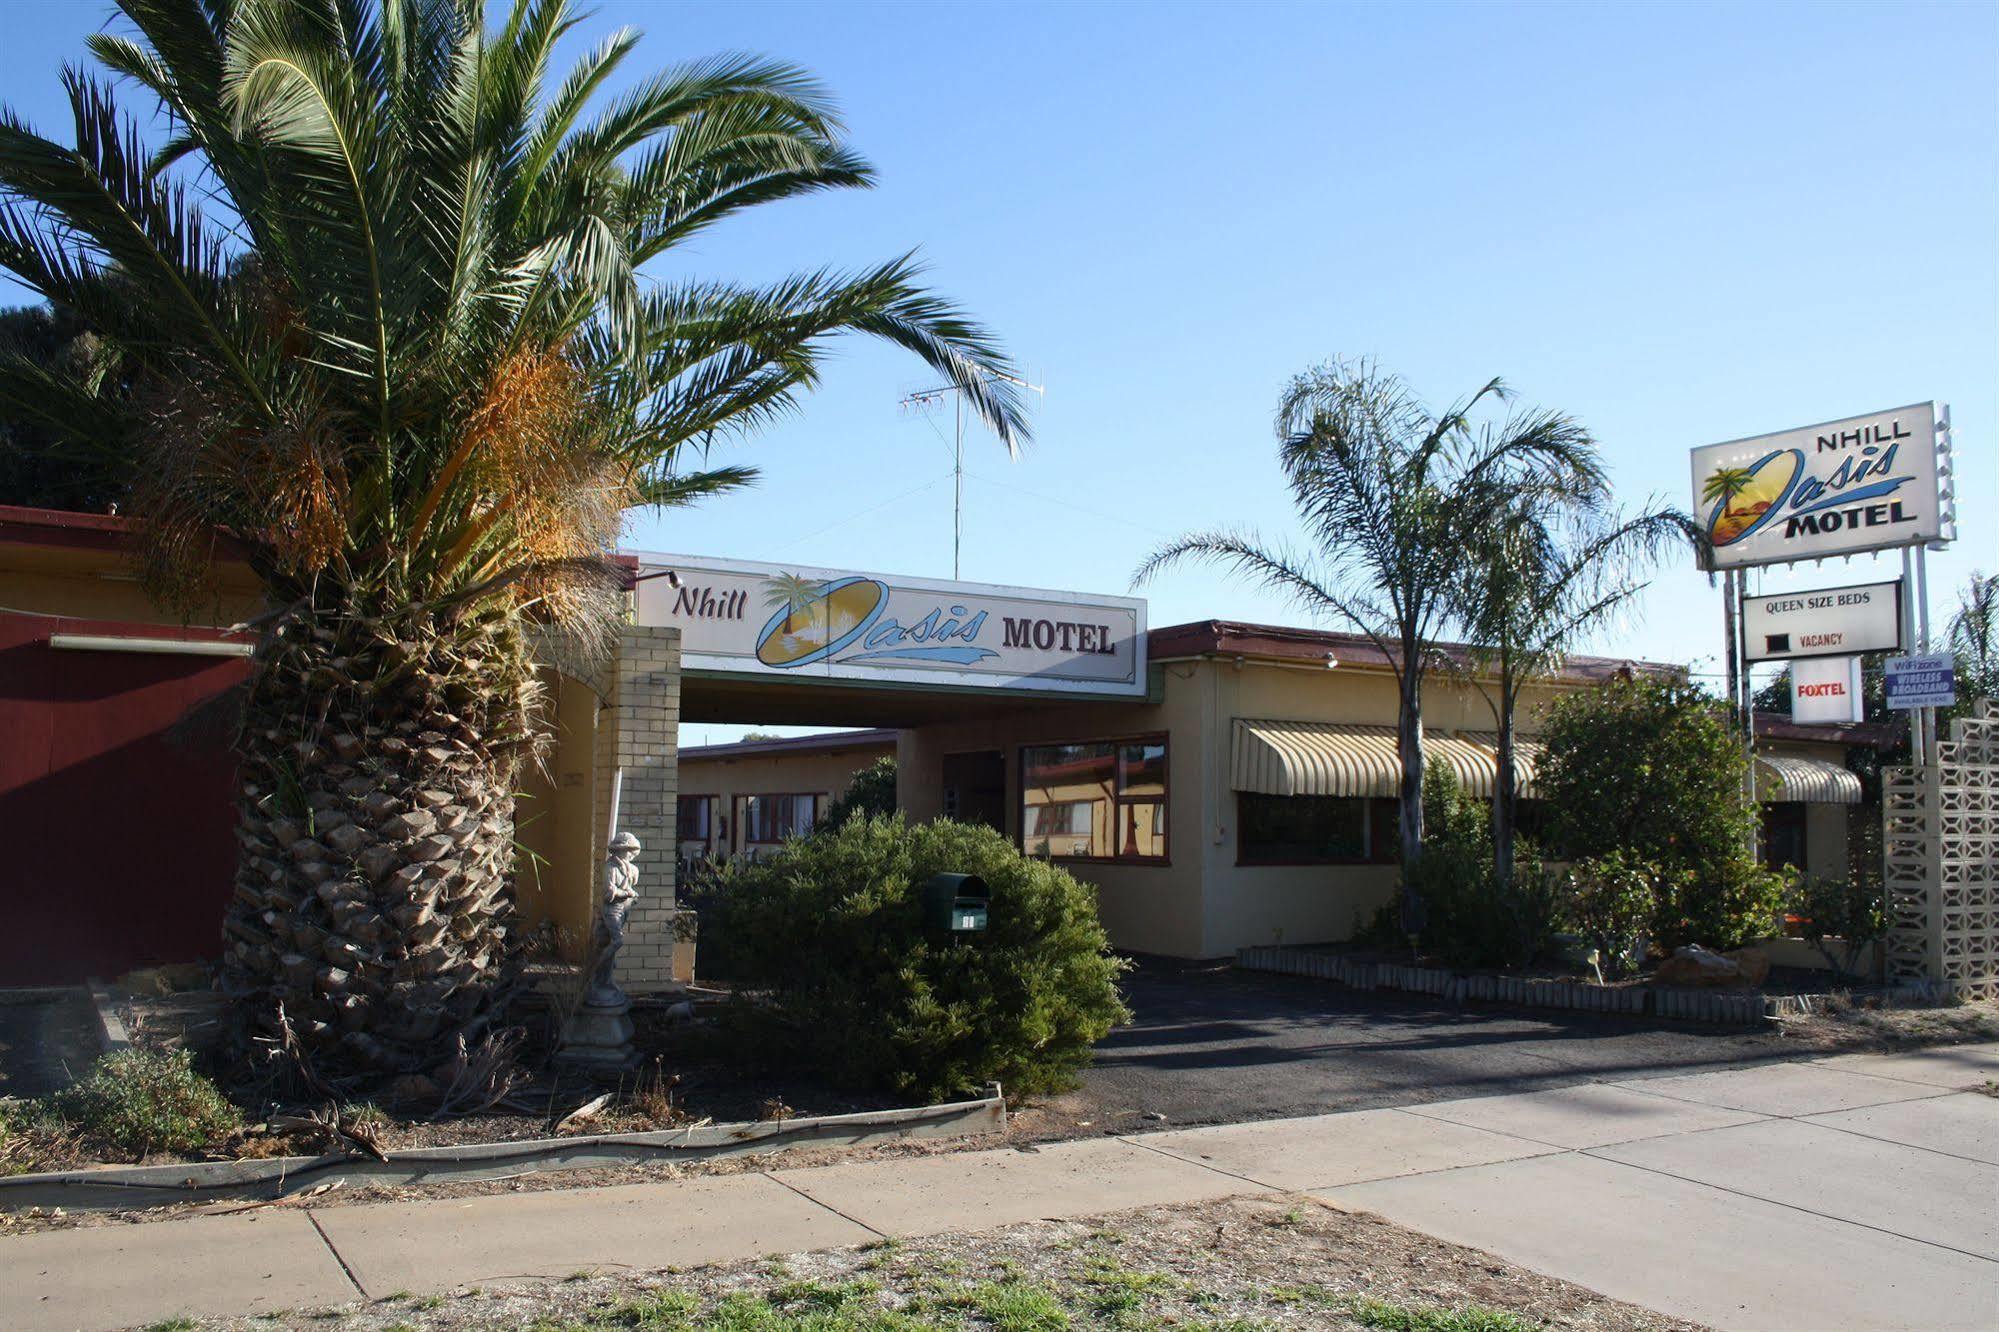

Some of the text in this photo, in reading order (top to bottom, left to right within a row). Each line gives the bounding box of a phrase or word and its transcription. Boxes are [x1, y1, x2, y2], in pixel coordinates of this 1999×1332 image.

[1816, 420, 1911, 453] NHILL
[1707, 443, 1900, 546] Oasis
[1784, 500, 1917, 539] MOTEL
[1766, 592, 1870, 614] QUEEN SIZE BEDS
[672, 576, 1116, 668] Nhill Oasis MOTEL
[1800, 633, 1843, 648] VACANCY
[1892, 681, 1950, 696] BROADBAND
[1896, 672, 1942, 685] WIRELESS
[1797, 683, 1846, 697] FOXTEL
